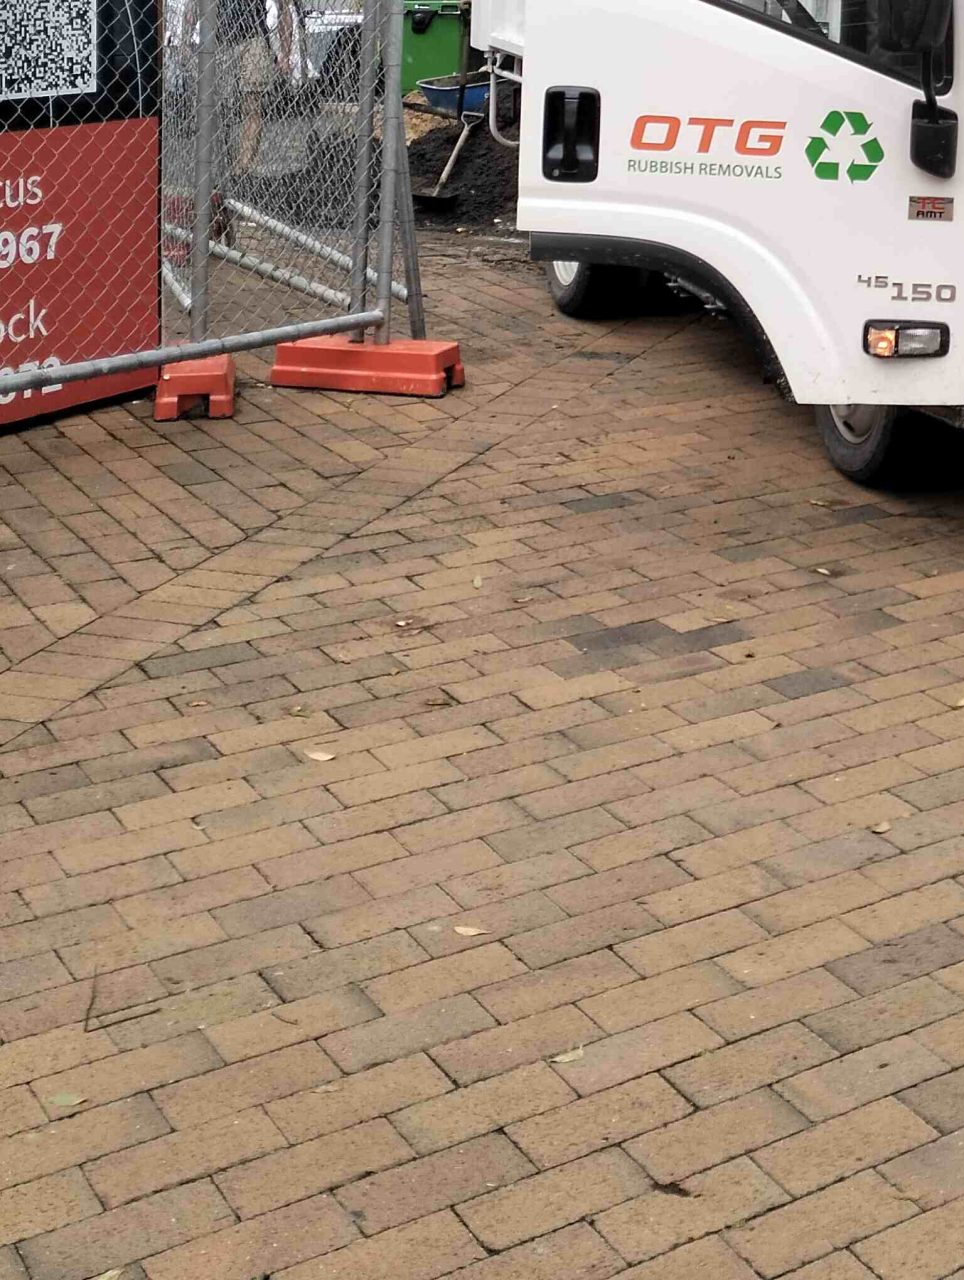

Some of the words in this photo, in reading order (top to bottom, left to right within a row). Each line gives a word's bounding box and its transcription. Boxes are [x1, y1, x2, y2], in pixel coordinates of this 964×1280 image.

[630, 115, 787, 157] OTG
[627, 159, 694, 175] RUBBISH
[698, 163, 782, 179] REMOVALS
[0, 175, 43, 207] us
[916, 210, 945, 219] AMT
[891, 282, 957, 303] 150
[0, 298, 48, 343] ck
